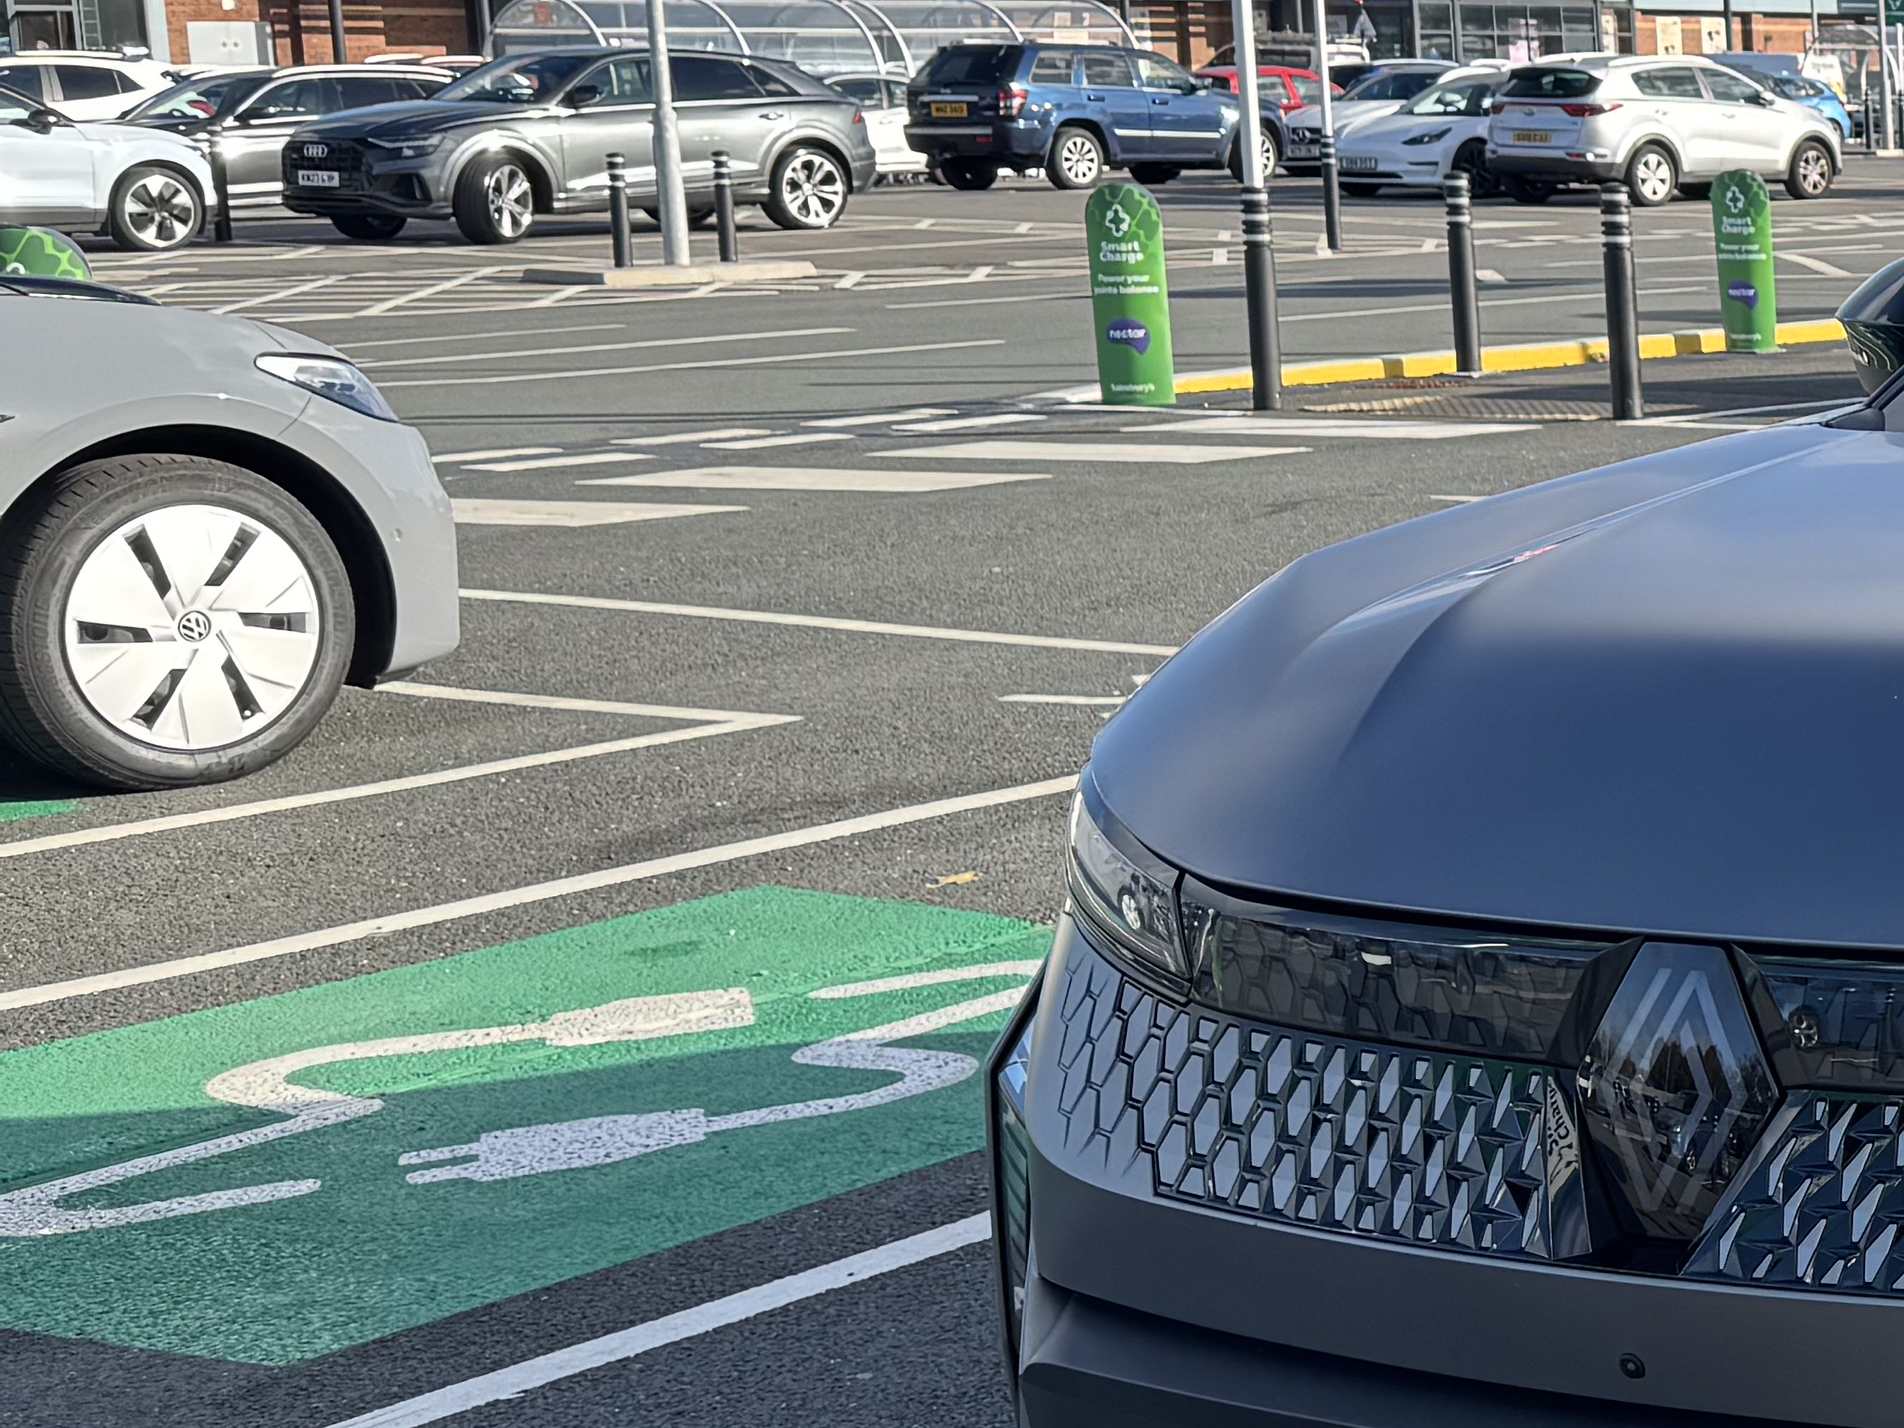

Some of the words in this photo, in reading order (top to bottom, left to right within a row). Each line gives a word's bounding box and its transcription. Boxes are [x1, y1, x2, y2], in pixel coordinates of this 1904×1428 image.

[1101, 241, 1140, 252] Smart
[1100, 252, 1144, 264] Charge
[1109, 329, 1146, 339] nectar
